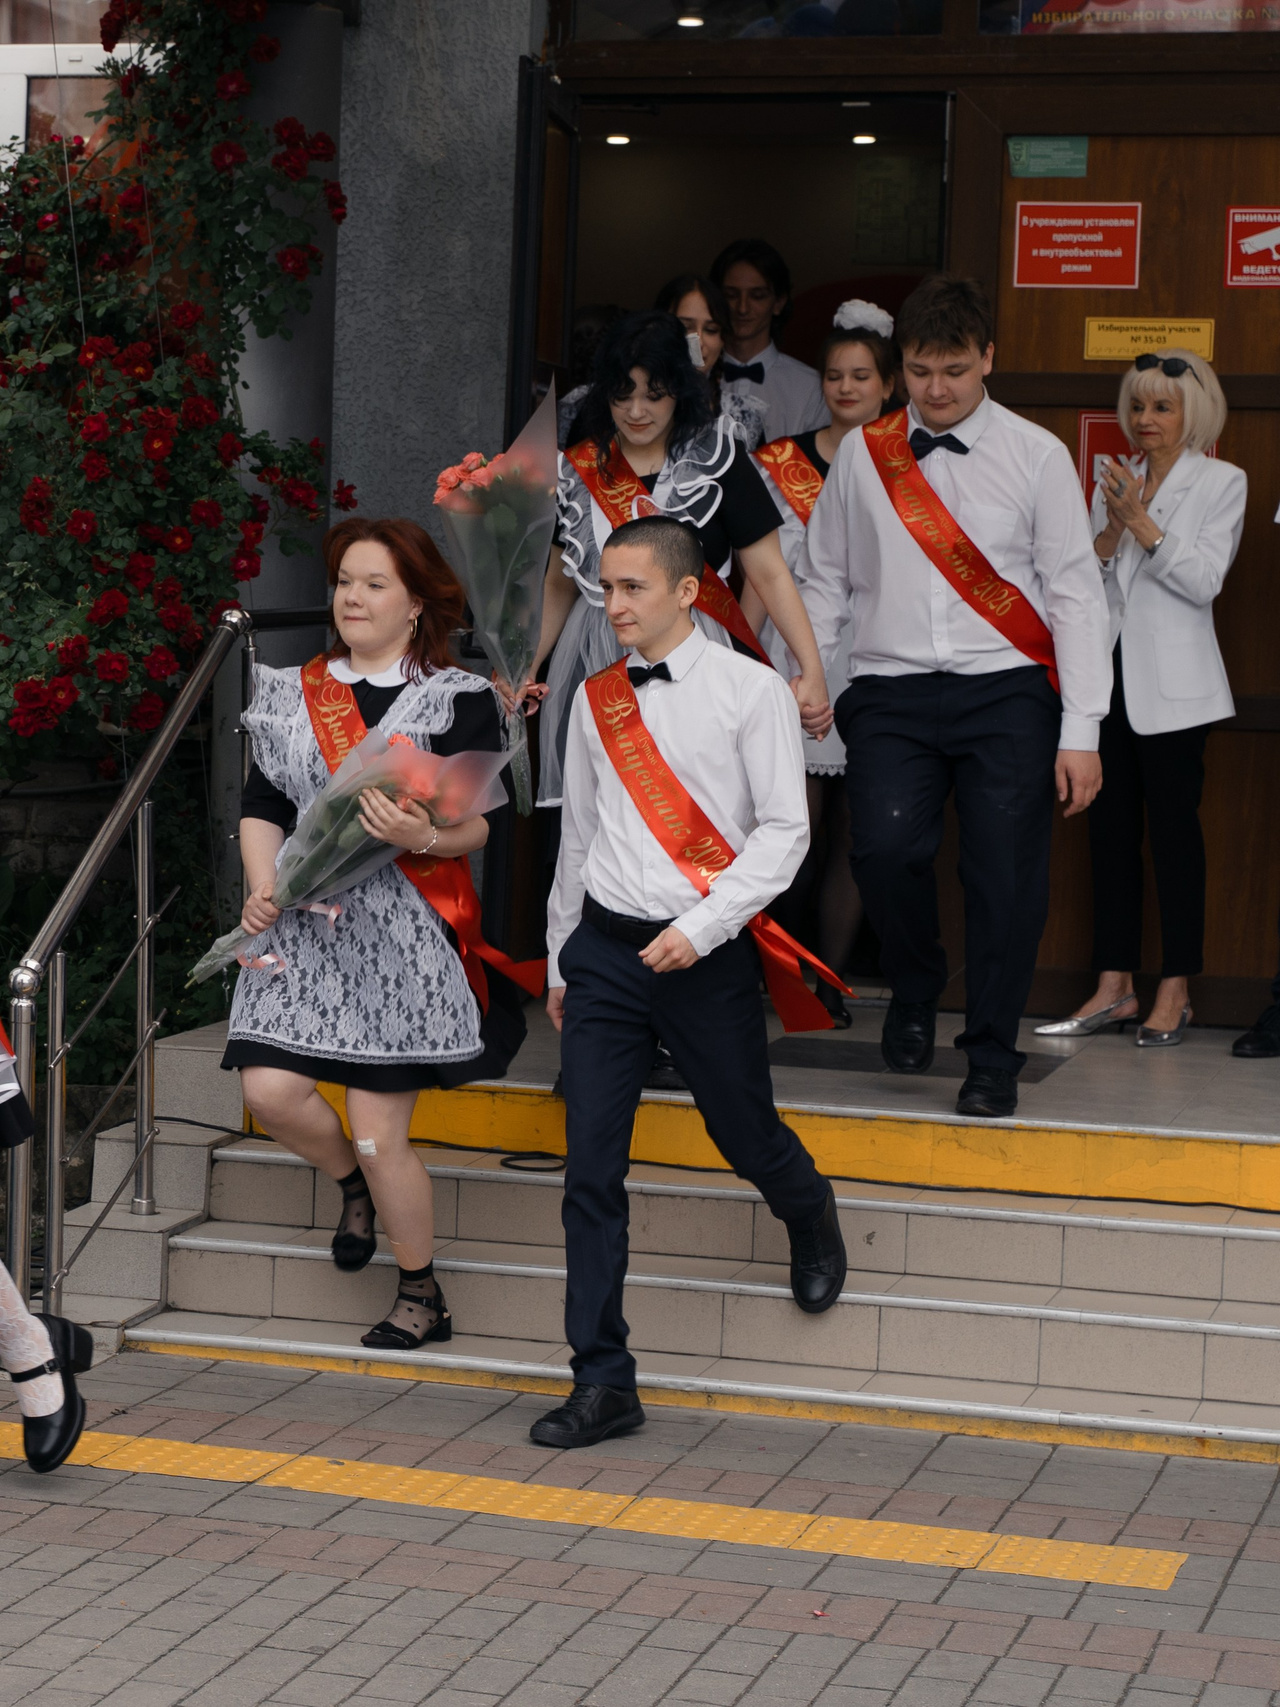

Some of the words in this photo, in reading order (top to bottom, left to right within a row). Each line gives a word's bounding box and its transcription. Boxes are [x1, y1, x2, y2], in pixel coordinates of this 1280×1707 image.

[1031, 9, 1176, 24] ИЗБИРАТЕЛЬНОГО
[1180, 8, 1256, 21] УЧАСТКА
[1022, 215, 1029, 226] В
[1029, 217, 1084, 228] учреждении
[1084, 218, 1135, 228] установлен
[1052, 232, 1104, 243] пропускной
[1032, 248, 1038, 257] и
[1060, 263, 1092, 274] режим
[1243, 264, 1280, 276] ВЕДЕТ
[1098, 323, 1167, 334] Избирательный
[1167, 326, 1201, 335] участок
[1143, 336, 1168, 345] 35-03
[971, 574, 1020, 616] 2026
[597, 670, 691, 839] Выпускник
